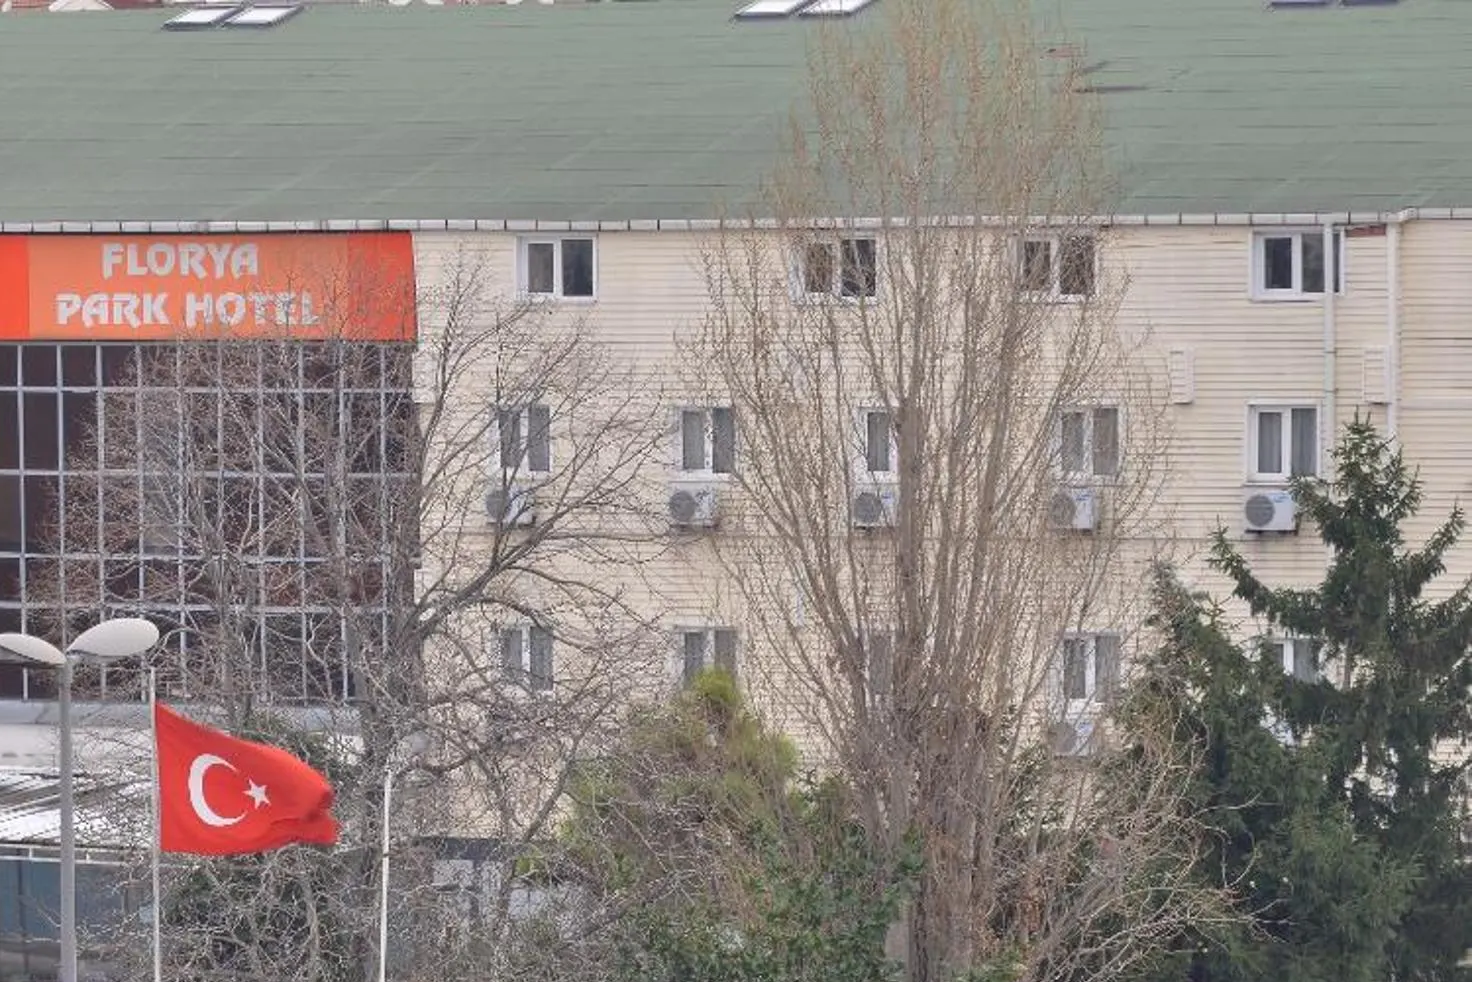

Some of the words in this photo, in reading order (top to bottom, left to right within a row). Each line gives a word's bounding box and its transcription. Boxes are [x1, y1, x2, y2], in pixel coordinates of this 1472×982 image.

[101, 242, 259, 280] FLORYA
[55, 291, 171, 328] PARK
[184, 290, 321, 328] HOTEL
